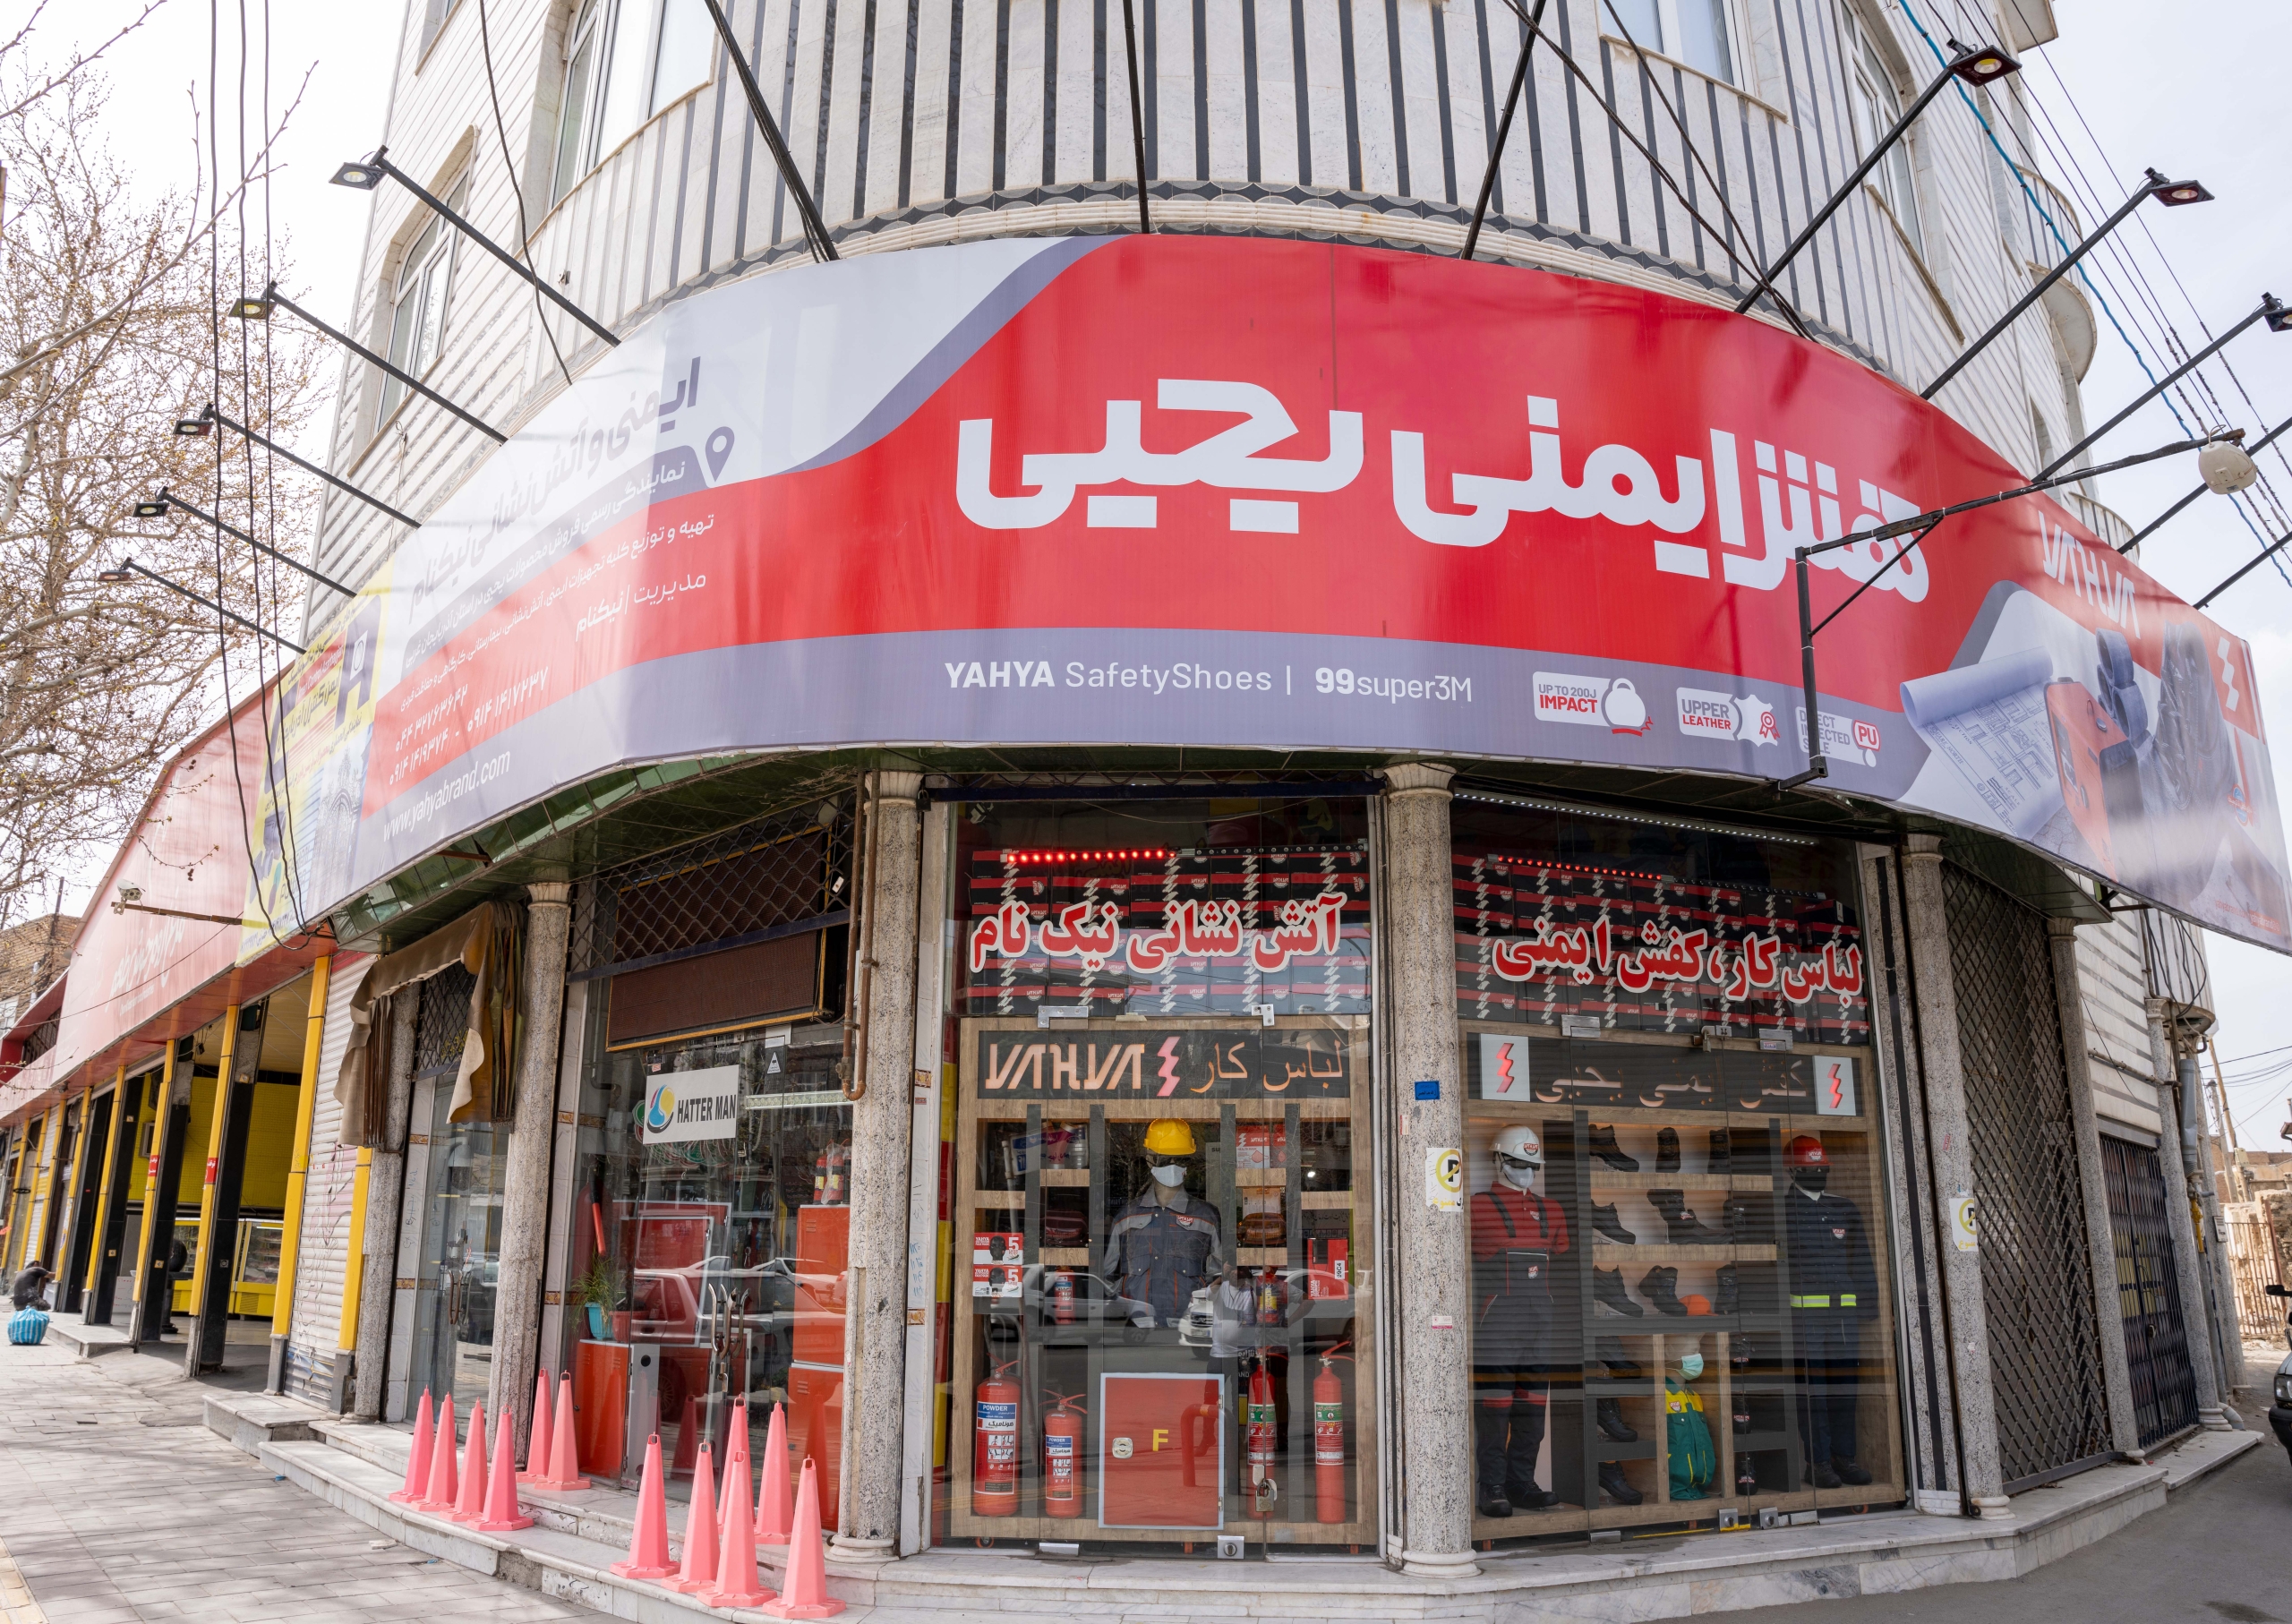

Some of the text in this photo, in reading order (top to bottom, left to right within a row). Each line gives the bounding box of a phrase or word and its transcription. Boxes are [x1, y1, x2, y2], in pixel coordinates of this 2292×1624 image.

[606, 356, 701, 463] ایمنی
[955, 378, 1364, 534] یحیی
[613, 461, 685, 514] نمایندگی
[1390, 395, 1746, 579] ایمنی
[548, 513, 580, 556] فروش
[581, 502, 611, 534] رسمی
[667, 527, 675, 543] و
[679, 514, 714, 538] تهیه
[606, 542, 629, 568] کلیه
[631, 526, 664, 560] توزیع
[506, 544, 548, 583] محصولات
[569, 555, 605, 589] تجهیزات
[483, 576, 505, 604] یحیی
[576, 574, 706, 642] مدیریت نیکنام
[945, 661, 1056, 688] YAHYA
[1065, 661, 1272, 695] SafetyShoes
[1315, 667, 1472, 705] 99super3M
[1538, 683, 1597, 698] UP TO 200J
[1539, 694, 1598, 714] IMPACT
[1681, 698, 1730, 719] UPPER
[1799, 709, 1835, 729] DECT
[1682, 714, 1732, 731] LEATHER
[1858, 725, 1877, 746] PU
[383, 750, 511, 842] www.yahyabrand.com
[971, 892, 1347, 974] آتش نشانی نیک نام
[1492, 913, 1612, 986] ایمنی
[1617, 919, 1707, 994] کفش
[1781, 939, 1863, 1009] لباس
[1190, 1039, 1344, 1094] لباس کار
[1535, 1056, 1809, 1109] کفش ایمنی یحیی
[677, 1094, 737, 1124] HATTER MAN
[1008, 1236, 1019, 1250] 5
[1008, 1269, 1019, 1282] 5
[982, 1404, 1008, 1412] POWDER
[1152, 1429, 1169, 1452] F
